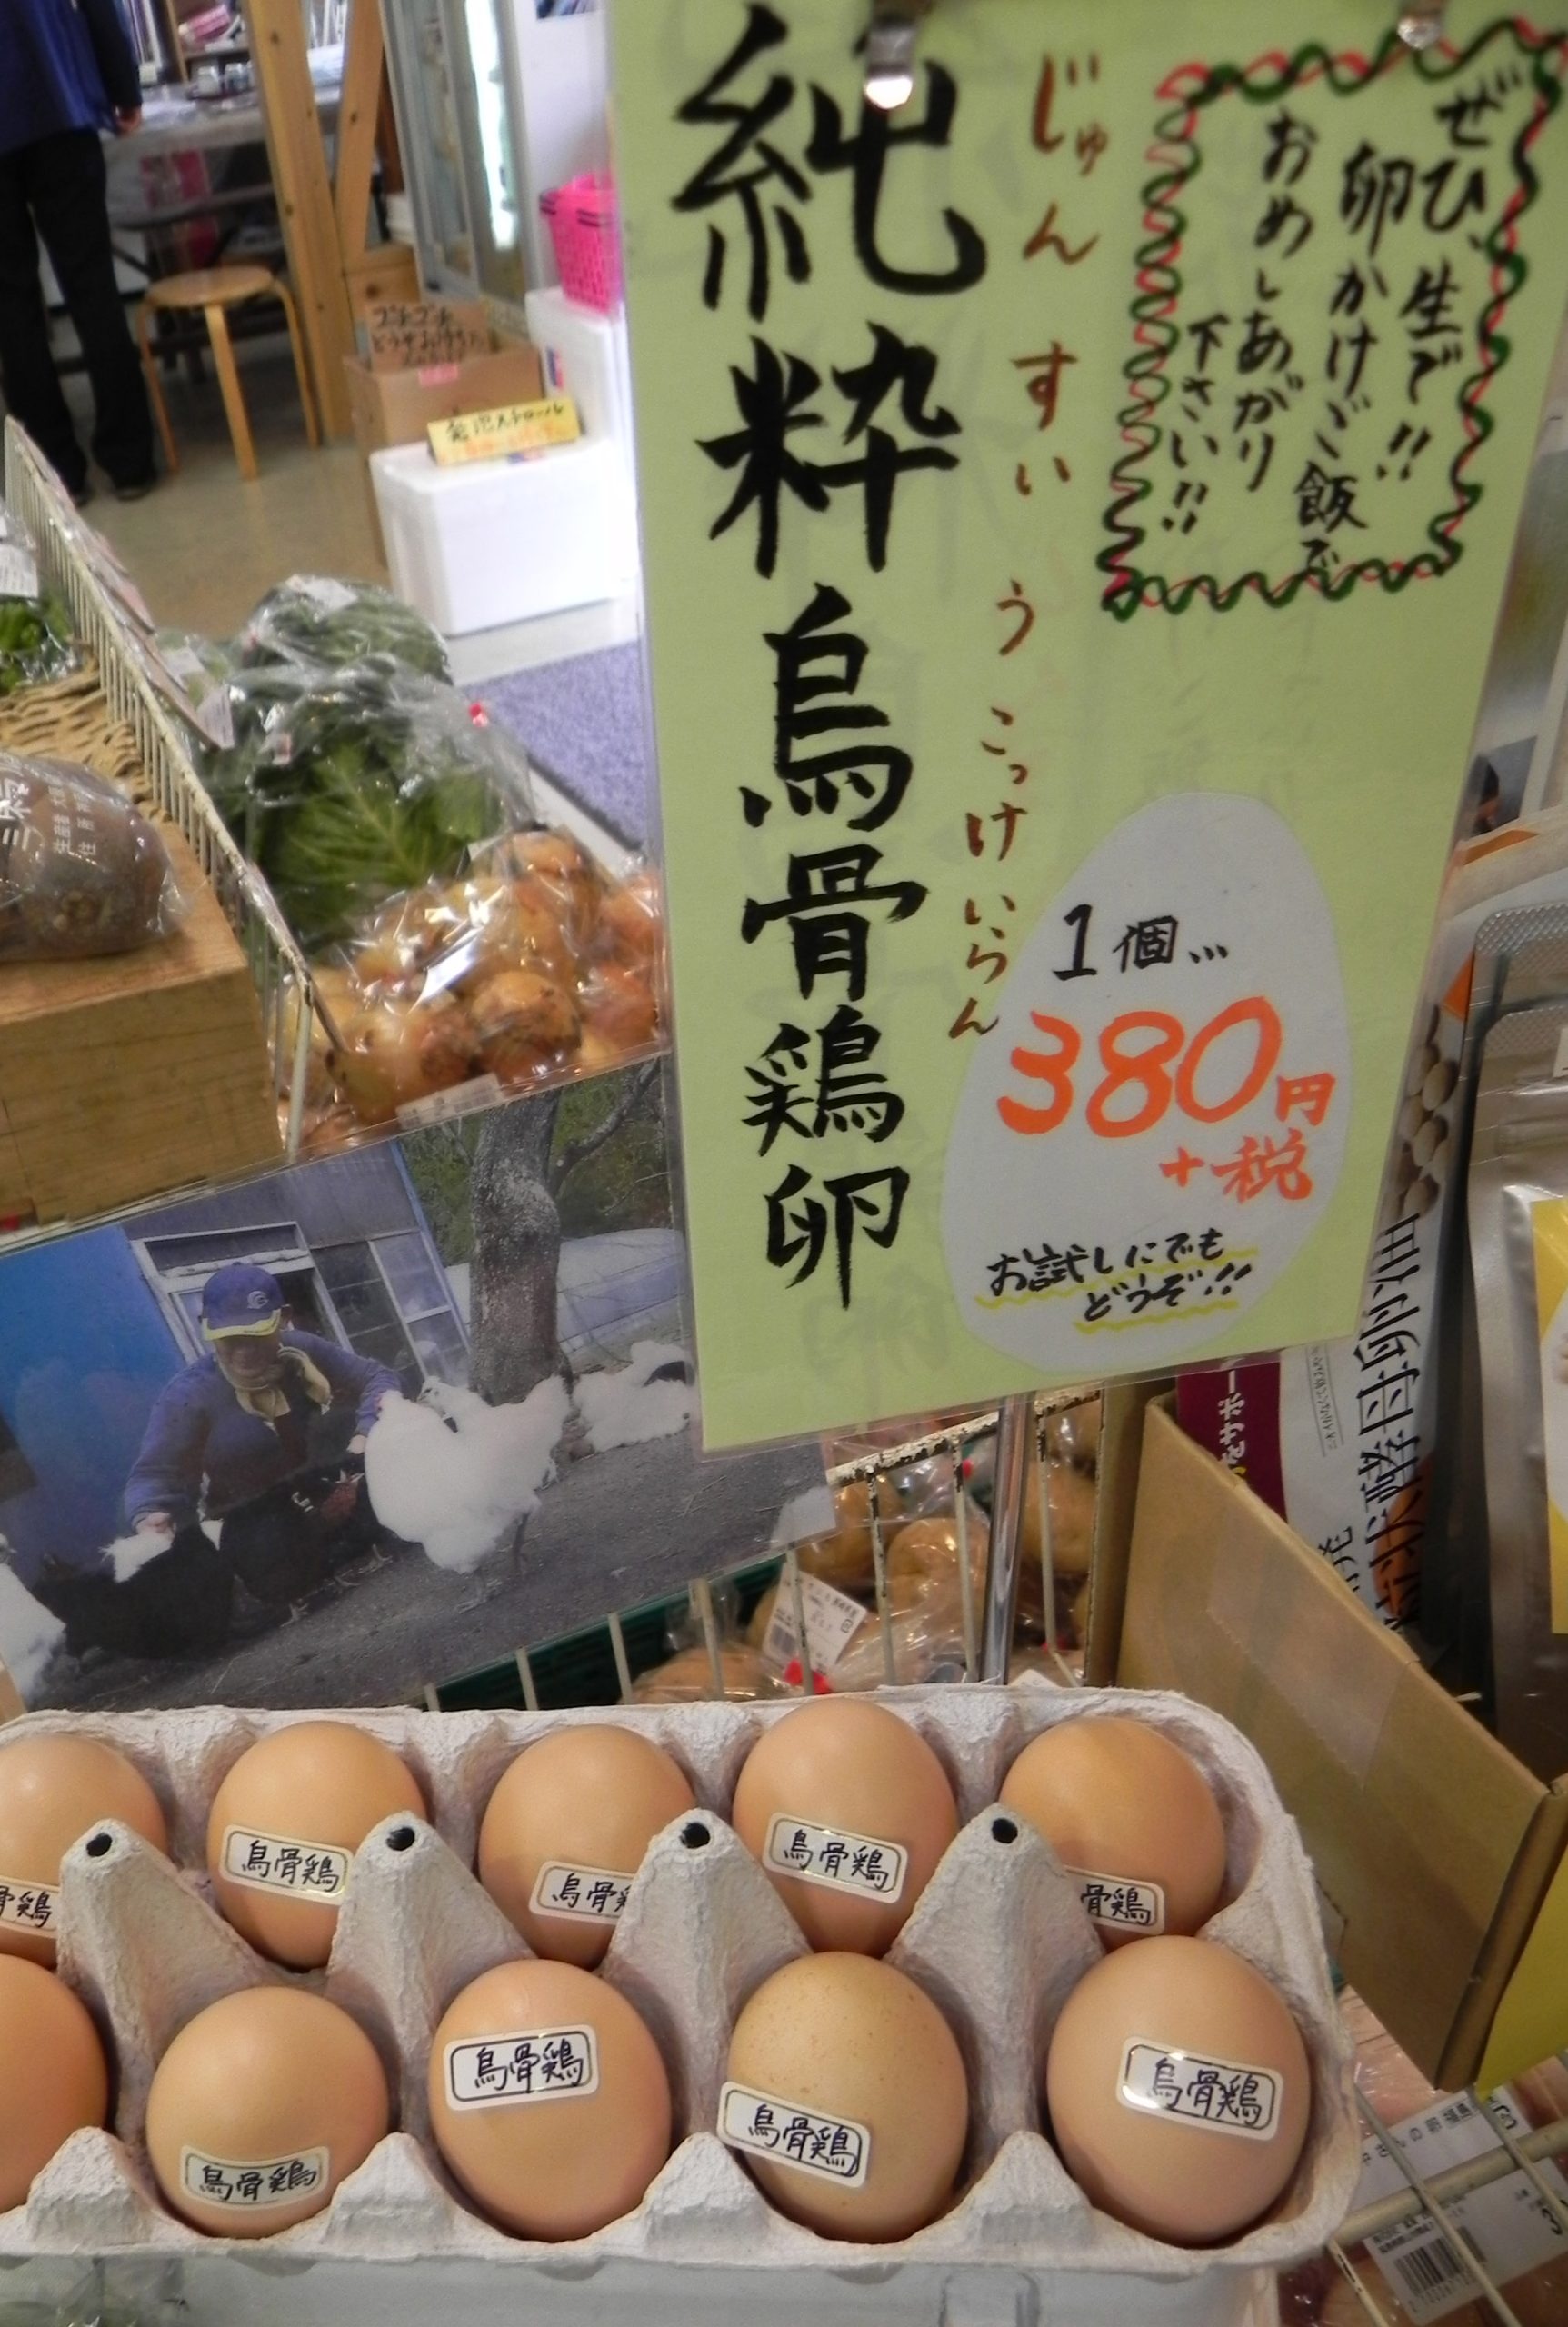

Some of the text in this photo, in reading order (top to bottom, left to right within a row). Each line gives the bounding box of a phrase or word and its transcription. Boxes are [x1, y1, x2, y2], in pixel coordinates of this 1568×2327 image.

[1233, 107, 1318, 492] おめしあがり
[1294, 141, 1416, 569] 卵かけご飯で
[670, 4, 986, 1309] 純粋烏骨鶏卵
[997, 996, 1336, 1138] 380円
[1161, 1128, 1314, 1203] +税
[986, 1228, 1224, 1296] お試しにでも
[1217, 1369, 1246, 1475] をサポー
